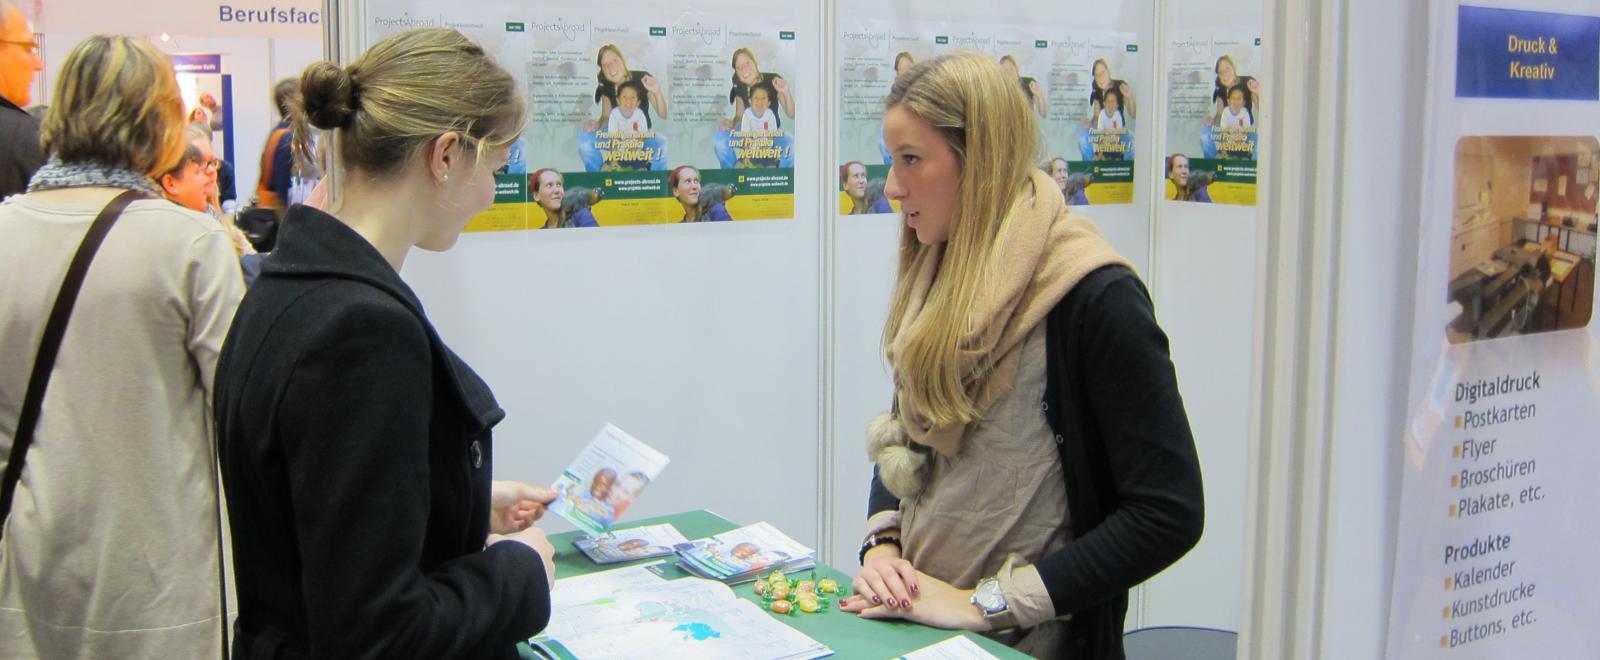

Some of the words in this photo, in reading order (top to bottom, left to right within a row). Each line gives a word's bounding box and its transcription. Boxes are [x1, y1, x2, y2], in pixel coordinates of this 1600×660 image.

[219, 5, 320, 24] Berufsfac
[1508, 34, 1545, 53] Druck
[1548, 37, 1557, 55] &
[1510, 61, 1554, 80] Kreativ
[603, 147, 653, 161] weltweit
[736, 145, 782, 160] weltweit
[1455, 370, 1541, 404] Digitaldruck
[1463, 403, 1536, 430] Postkarten
[1462, 438, 1497, 461] Flyer
[1460, 459, 1536, 489] Broschüren
[1457, 491, 1514, 518] Plakate,
[1519, 485, 1545, 504] etc.
[1444, 534, 1511, 564] Produkte
[1453, 560, 1516, 590] Kalender
[1451, 581, 1536, 619] Kunstdrucke
[1449, 619, 1507, 648] Buttons,
[1511, 609, 1537, 629] etc.
